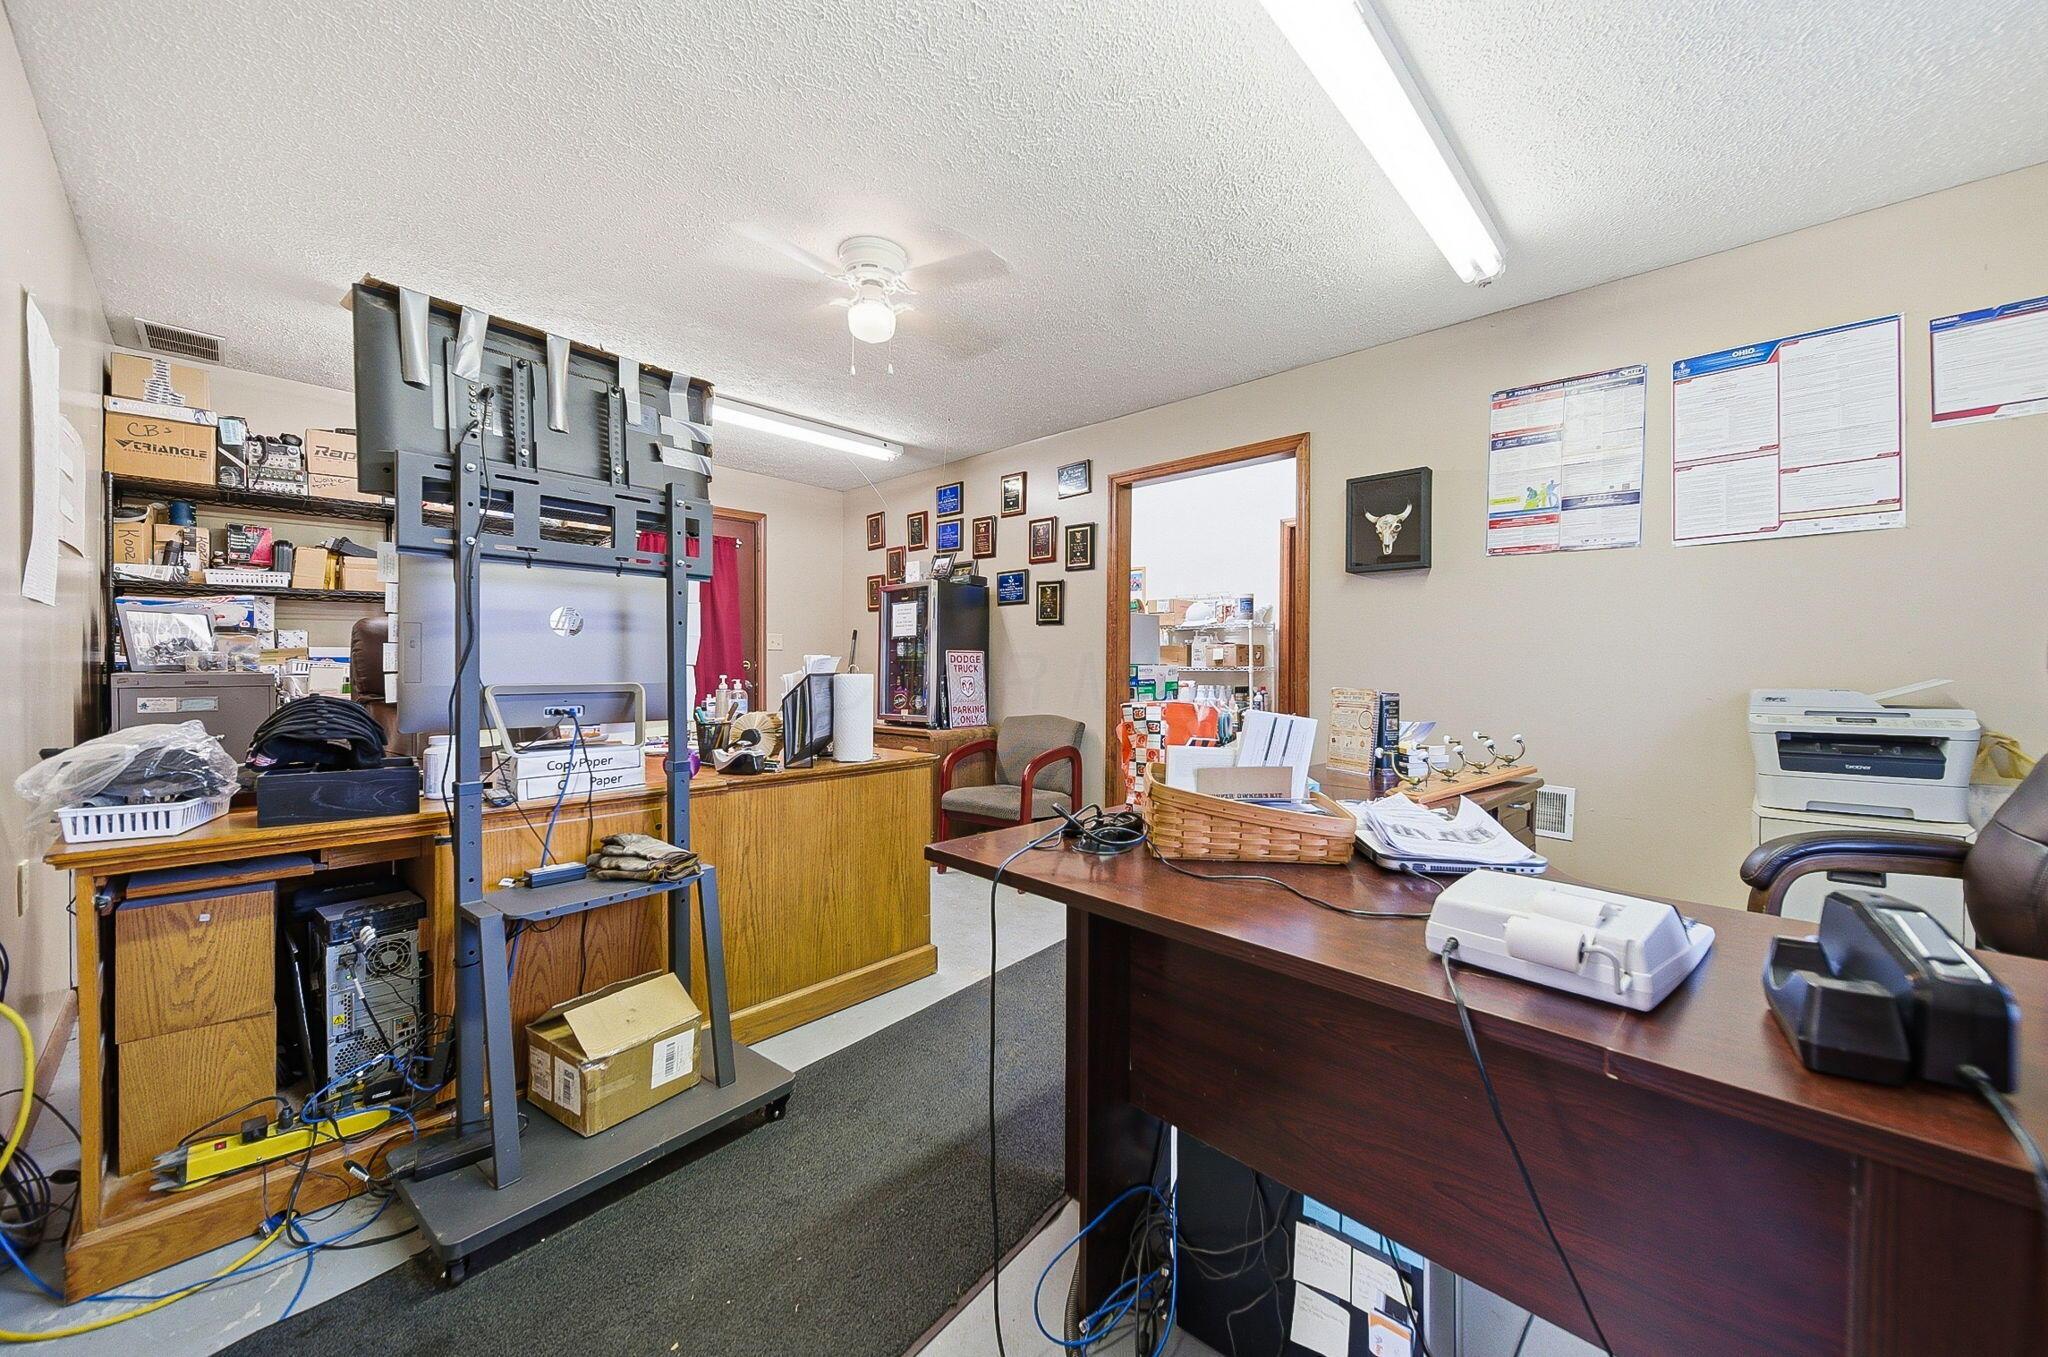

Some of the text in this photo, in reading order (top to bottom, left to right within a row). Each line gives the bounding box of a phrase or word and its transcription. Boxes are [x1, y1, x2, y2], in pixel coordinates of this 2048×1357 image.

[1731, 347, 1755, 357] OHIO
[133, 441, 208, 459] TRIANGLE
[950, 654, 981, 664] DODGE
[953, 664, 979, 673] TRUCK
[952, 705, 985, 714] PARKING
[960, 714, 980, 724] ONLY
[546, 756, 614, 773] Copy Paper
[590, 775, 623, 788] Paper
